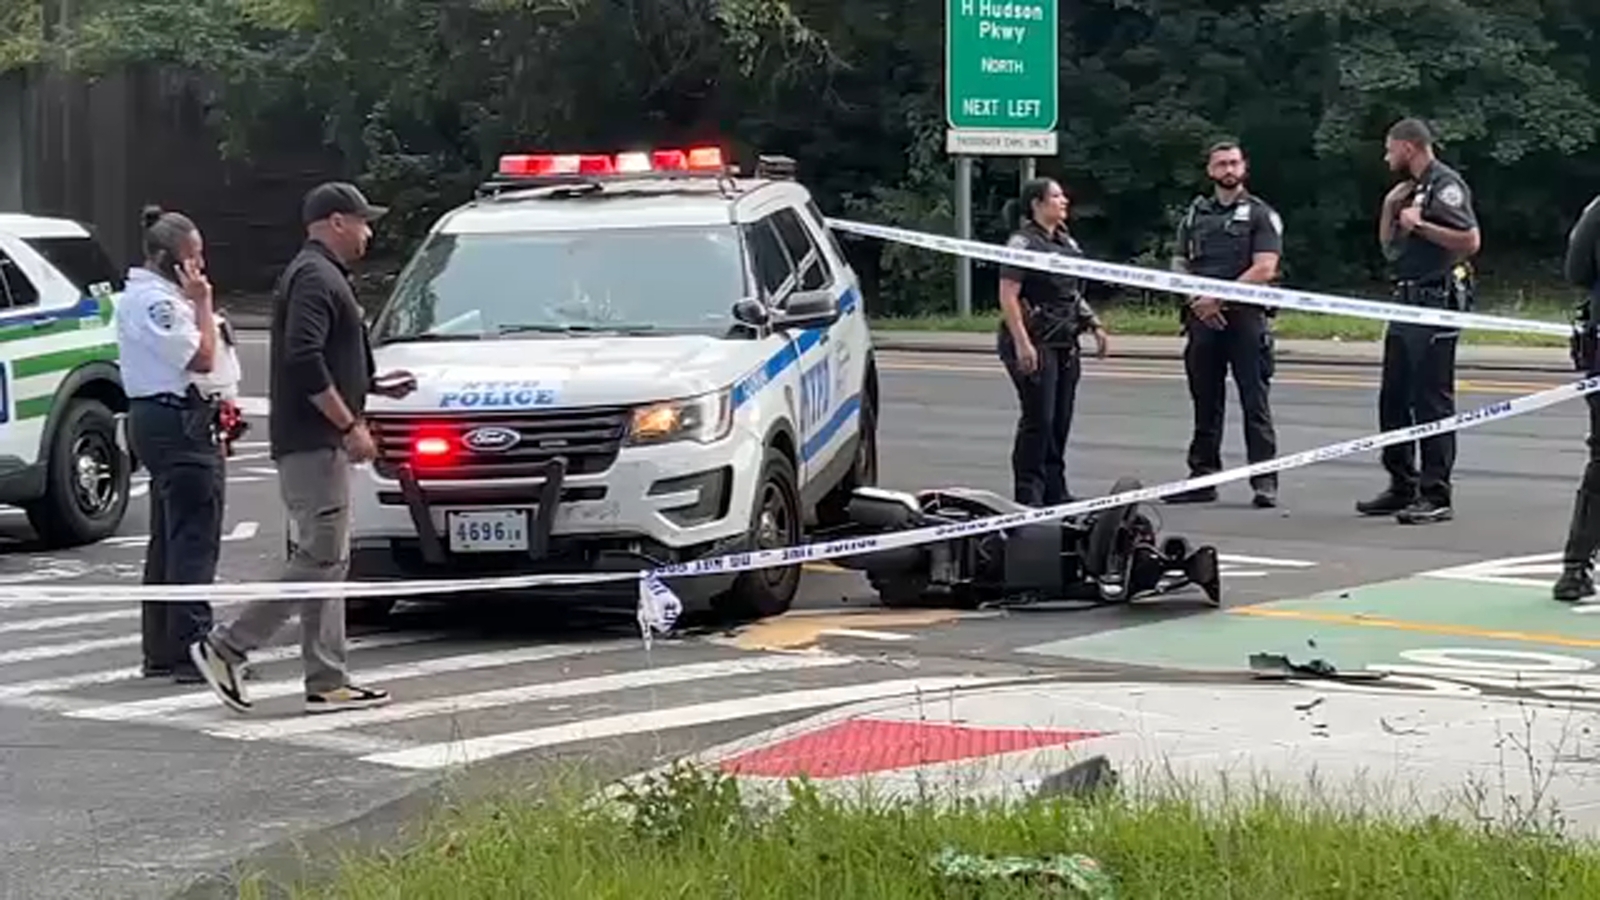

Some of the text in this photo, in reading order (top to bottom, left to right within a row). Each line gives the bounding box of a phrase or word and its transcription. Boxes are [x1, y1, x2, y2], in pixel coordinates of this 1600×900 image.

[979, 0, 1043, 20] Hudson
[979, 20, 1026, 44] Pkwy
[981, 57, 1024, 74] NORTH
[963, 99, 1041, 118] NEXT LEFT
[439, 389, 556, 408] POLICE
[456, 522, 505, 541] 4696
